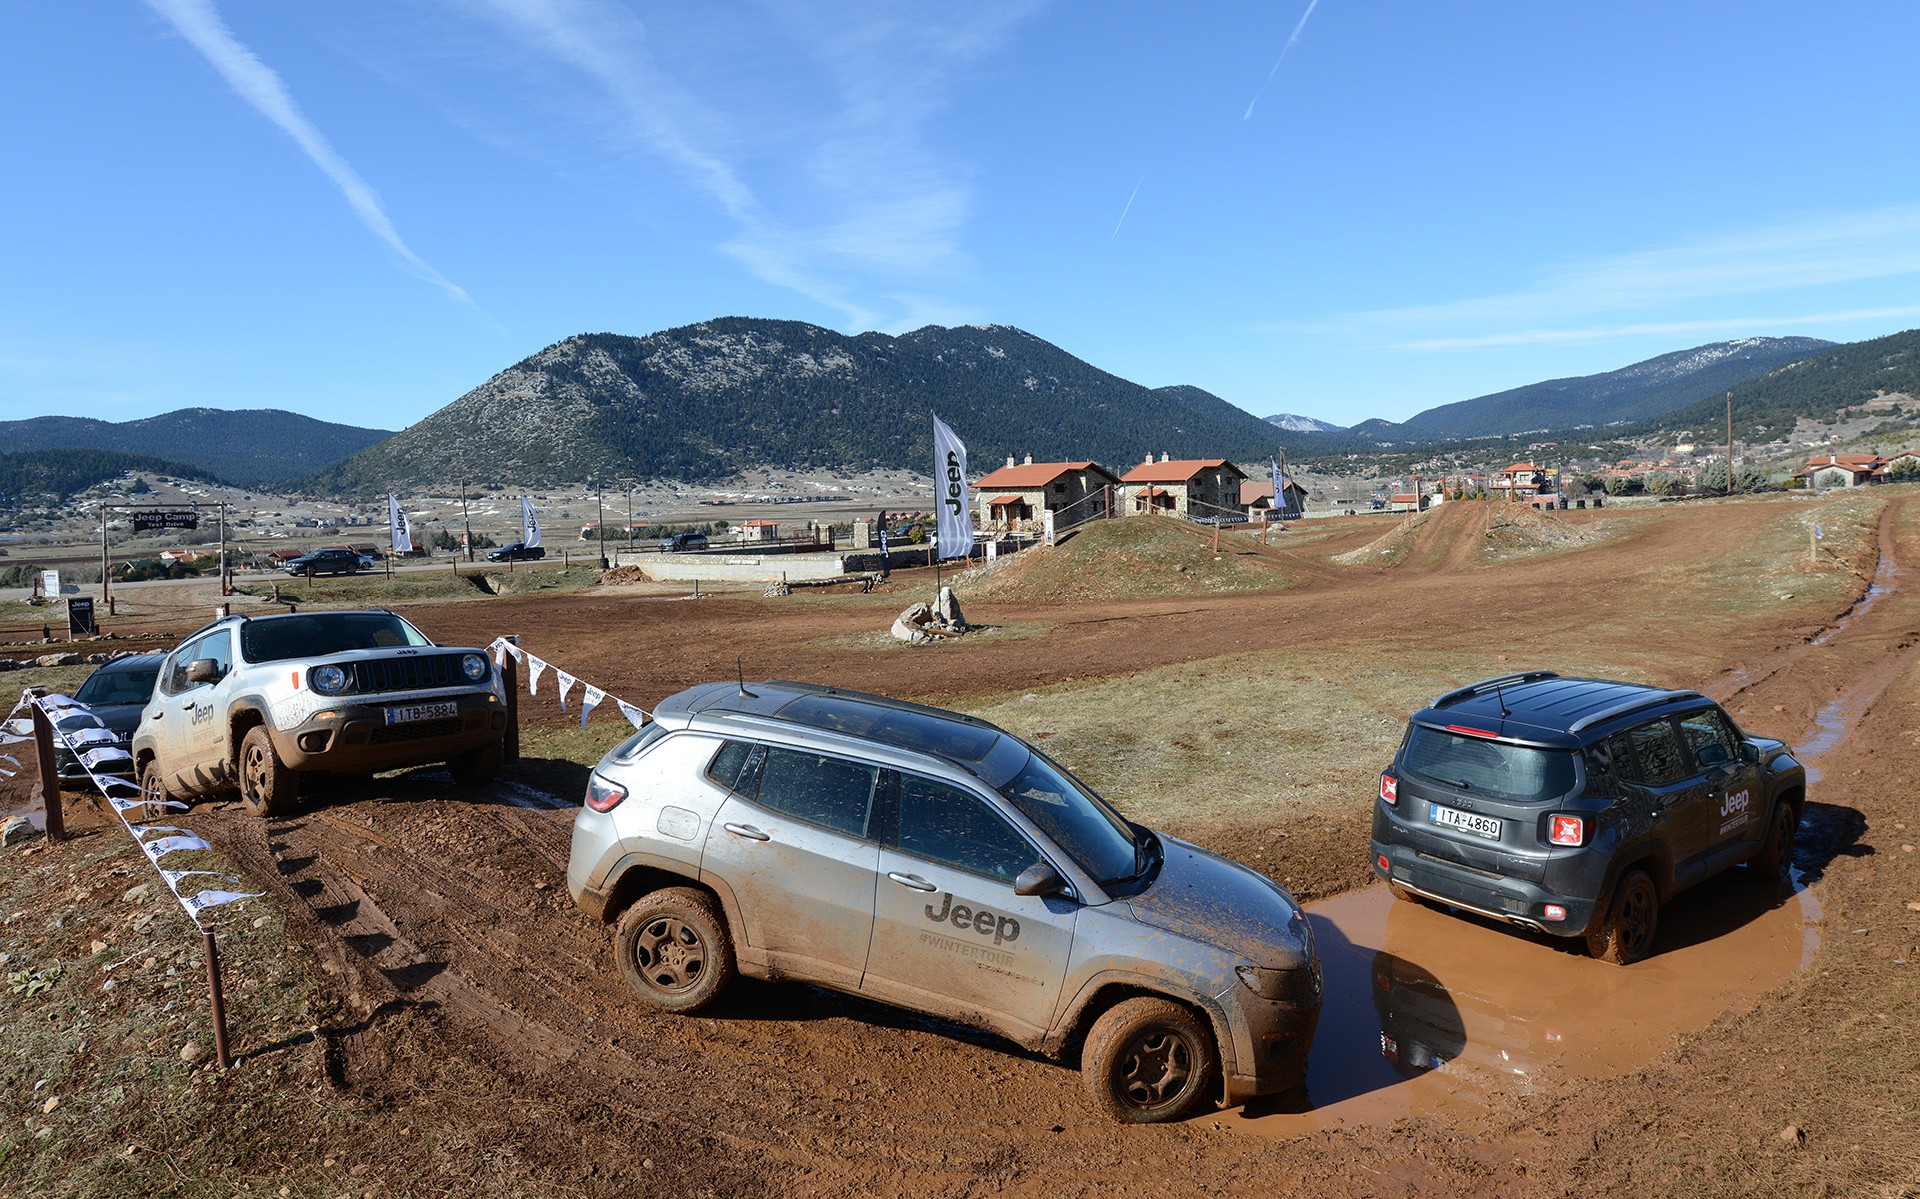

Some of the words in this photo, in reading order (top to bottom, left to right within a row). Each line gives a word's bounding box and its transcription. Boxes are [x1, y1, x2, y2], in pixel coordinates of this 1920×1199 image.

[945, 450, 961, 516] Jeep
[135, 513, 162, 522] Jeep
[165, 513, 195, 522] Camp
[587, 687, 601, 700] Jeep
[191, 703, 214, 726] Jeep
[1720, 788, 1749, 817] Jeep
[1441, 809, 1498, 834] ITA-4860
[924, 892, 1020, 946] Jeep
[919, 933, 1015, 968] #WINTERTOUR
